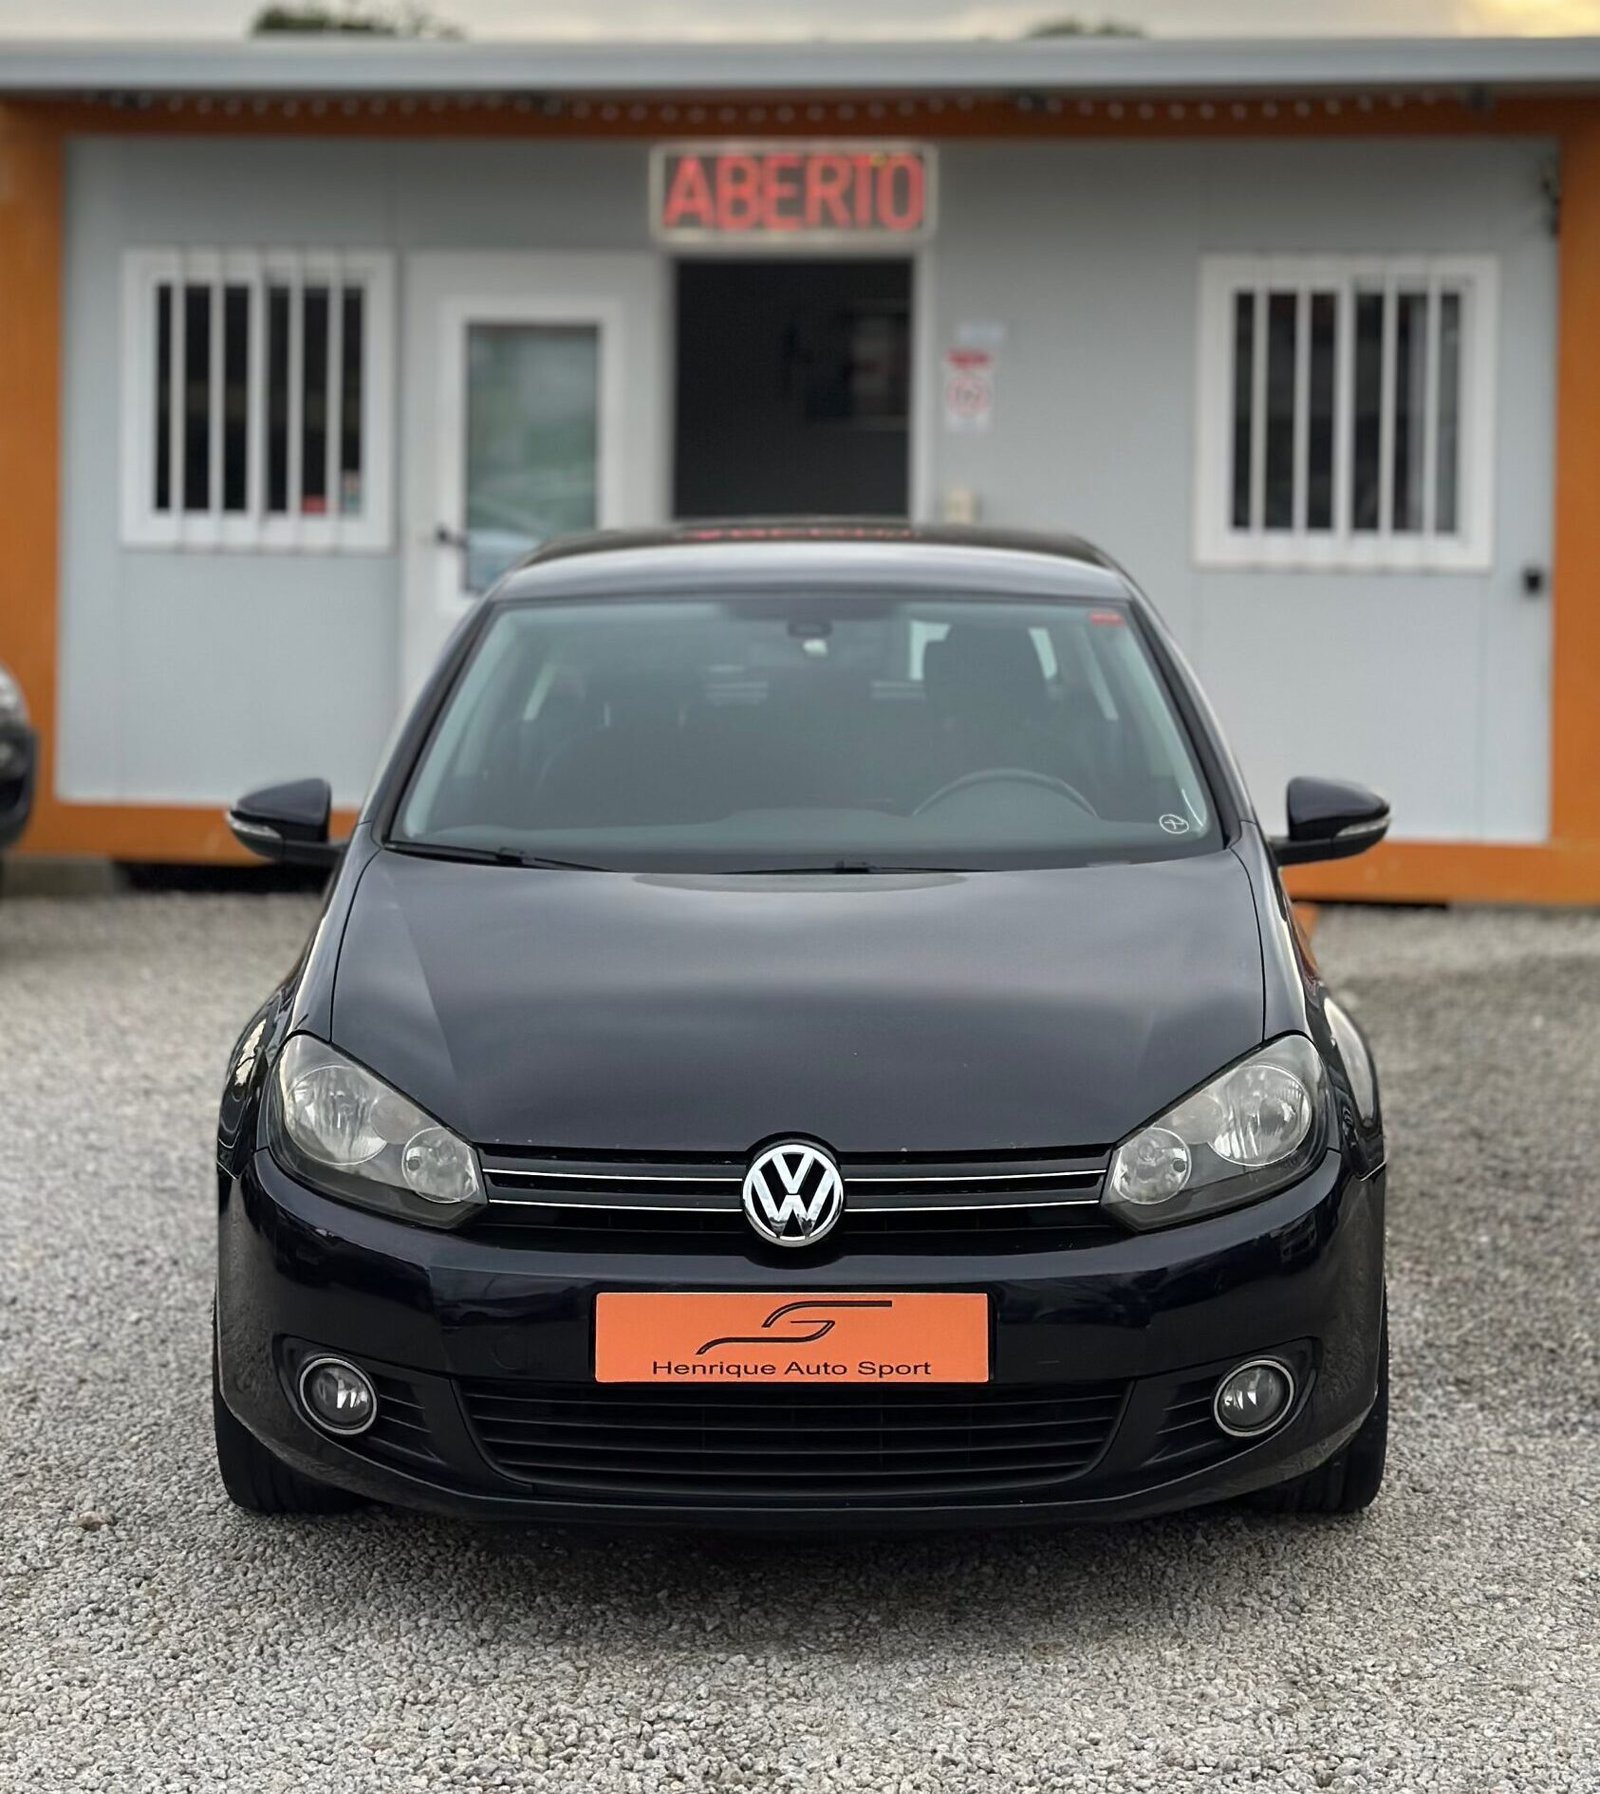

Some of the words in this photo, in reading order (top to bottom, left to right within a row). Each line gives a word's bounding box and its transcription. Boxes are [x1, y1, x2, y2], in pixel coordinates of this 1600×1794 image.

[662, 152, 926, 232] ABERTO
[652, 1360, 777, 1378] Henrique
[784, 1360, 848, 1375] Auto
[857, 1360, 932, 1378] Sport
